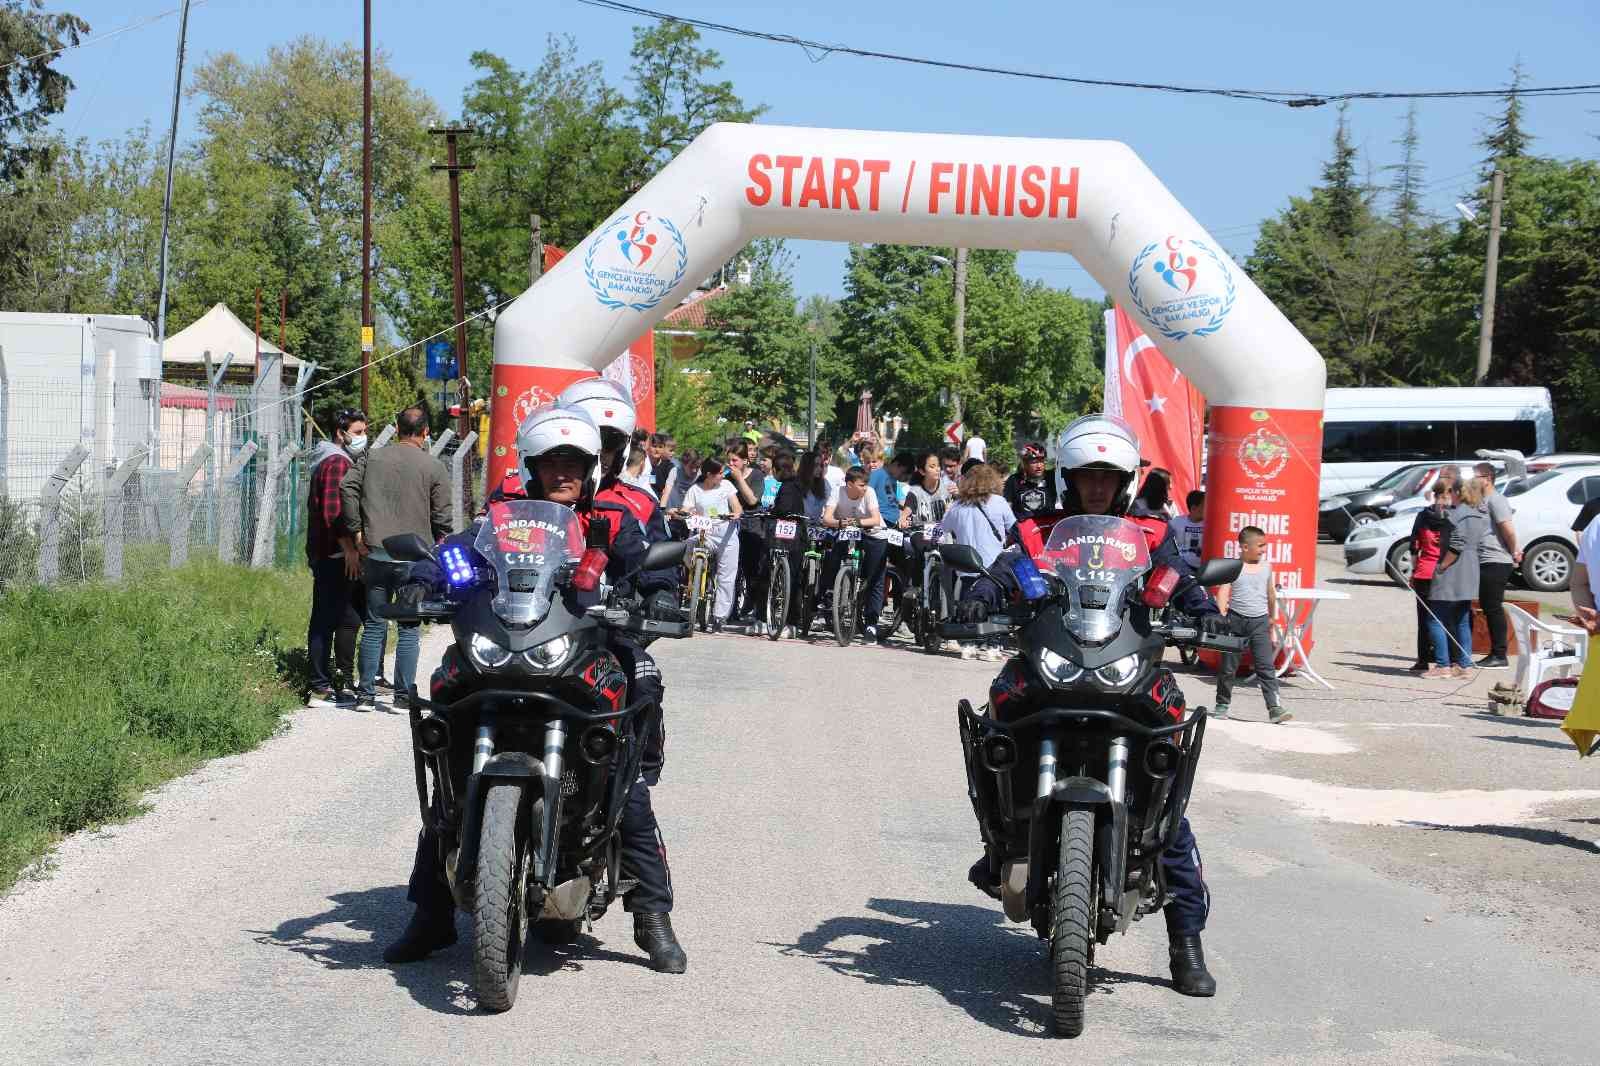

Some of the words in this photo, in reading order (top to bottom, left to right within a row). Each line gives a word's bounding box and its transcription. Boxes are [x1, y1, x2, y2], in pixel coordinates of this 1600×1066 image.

[745, 153, 891, 212] START
[901, 160, 916, 214] /
[928, 162, 1080, 219] FINISH
[492, 519, 565, 539] JANDARMA
[1230, 509, 1290, 535] EDİRNE
[518, 554, 545, 565] 112
[1088, 571, 1115, 582] 112
